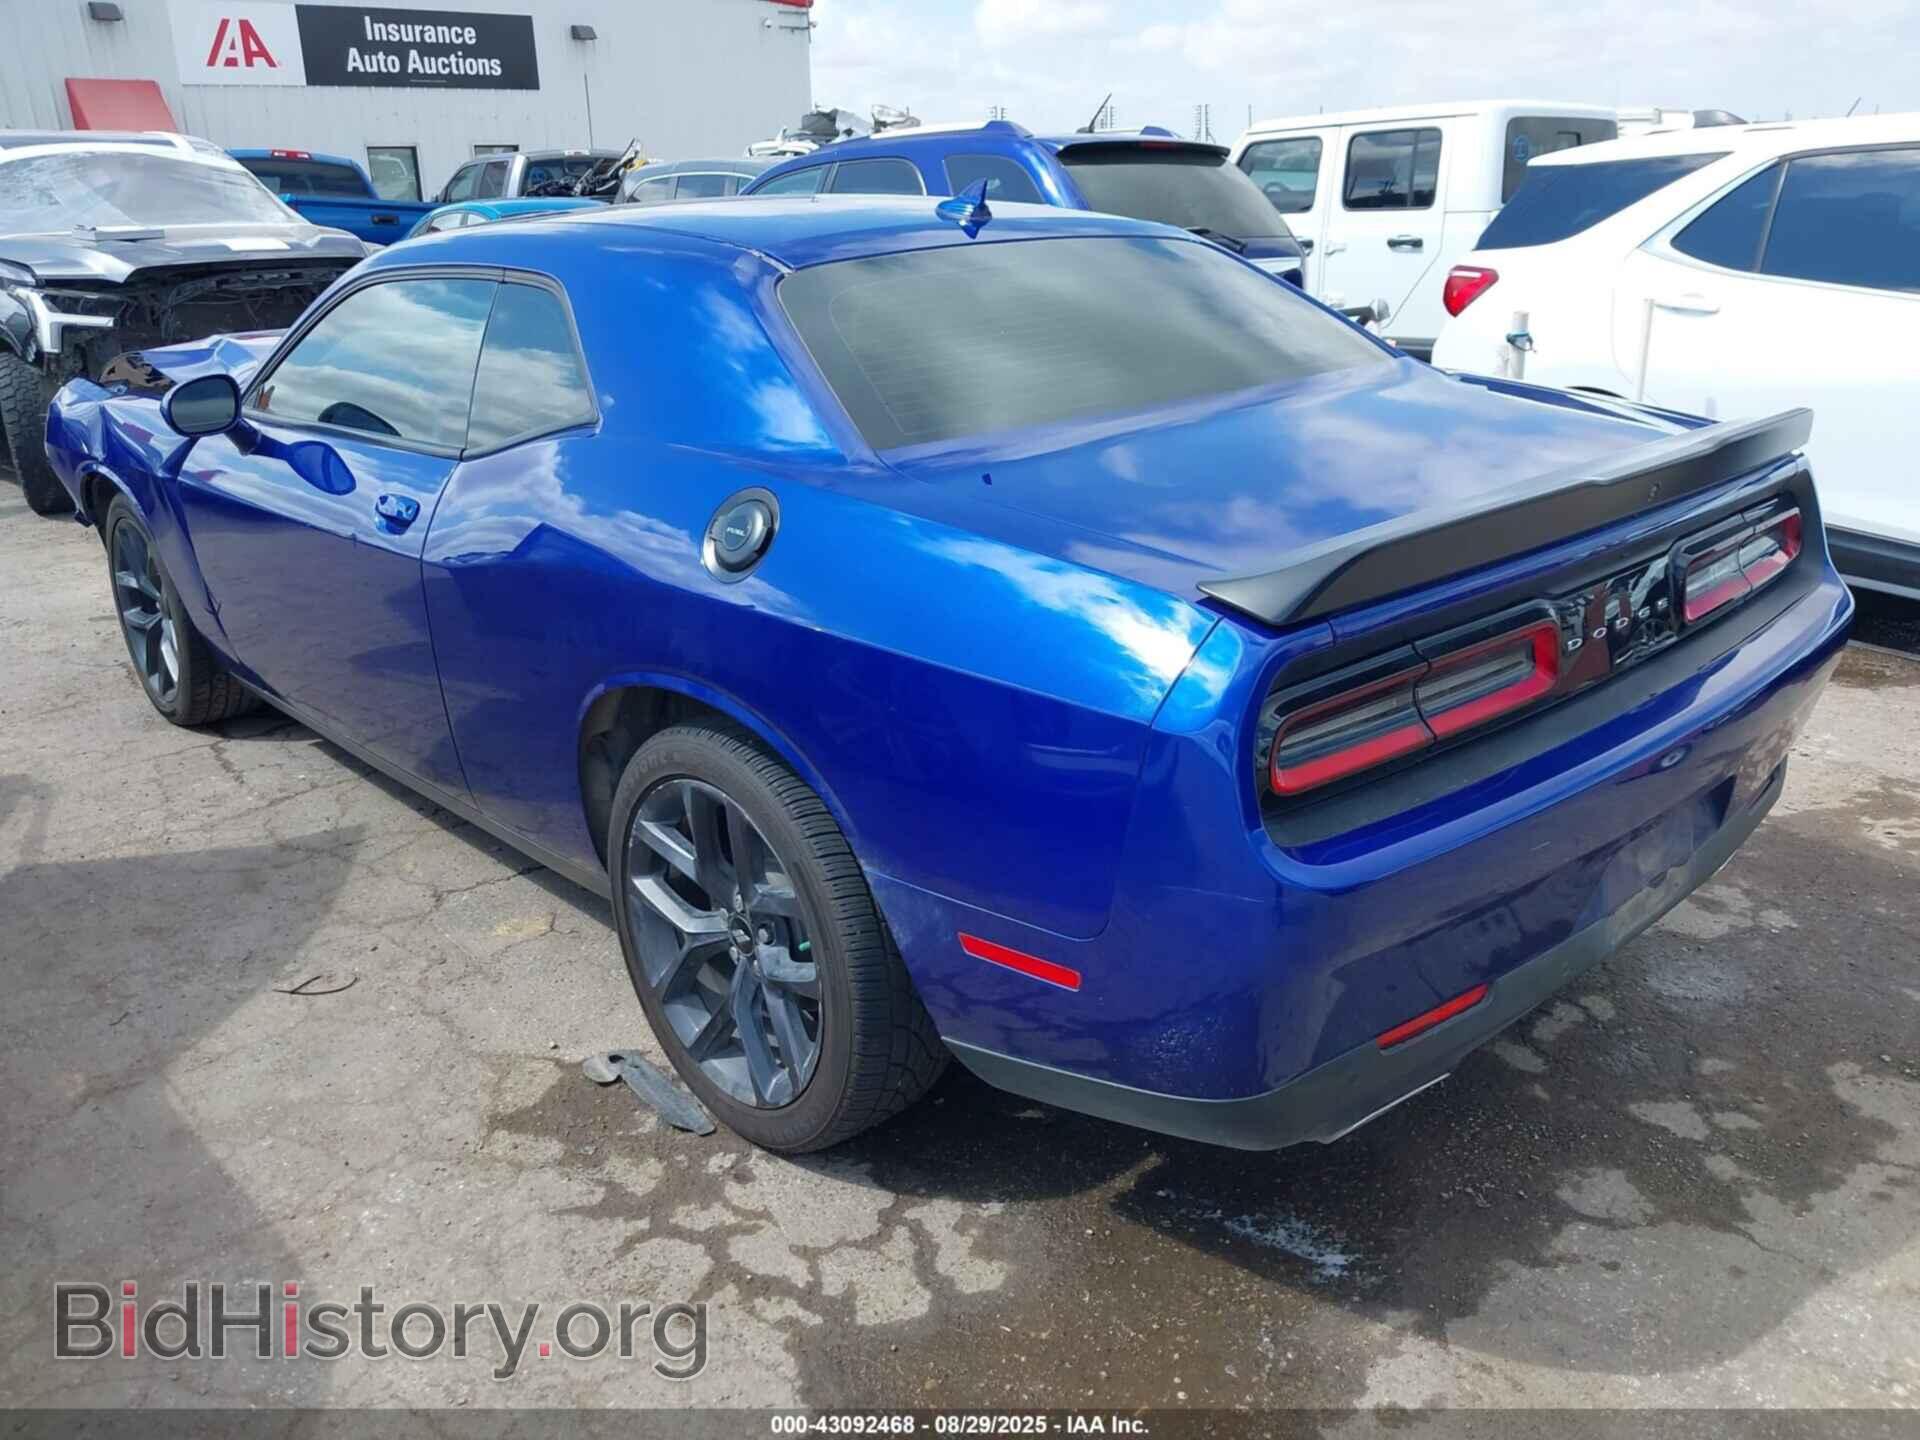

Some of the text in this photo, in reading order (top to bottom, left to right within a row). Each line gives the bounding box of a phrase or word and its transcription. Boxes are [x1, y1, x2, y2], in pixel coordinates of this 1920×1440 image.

[364, 15, 477, 45] Insurance
[347, 47, 502, 76] Auto Auctions
